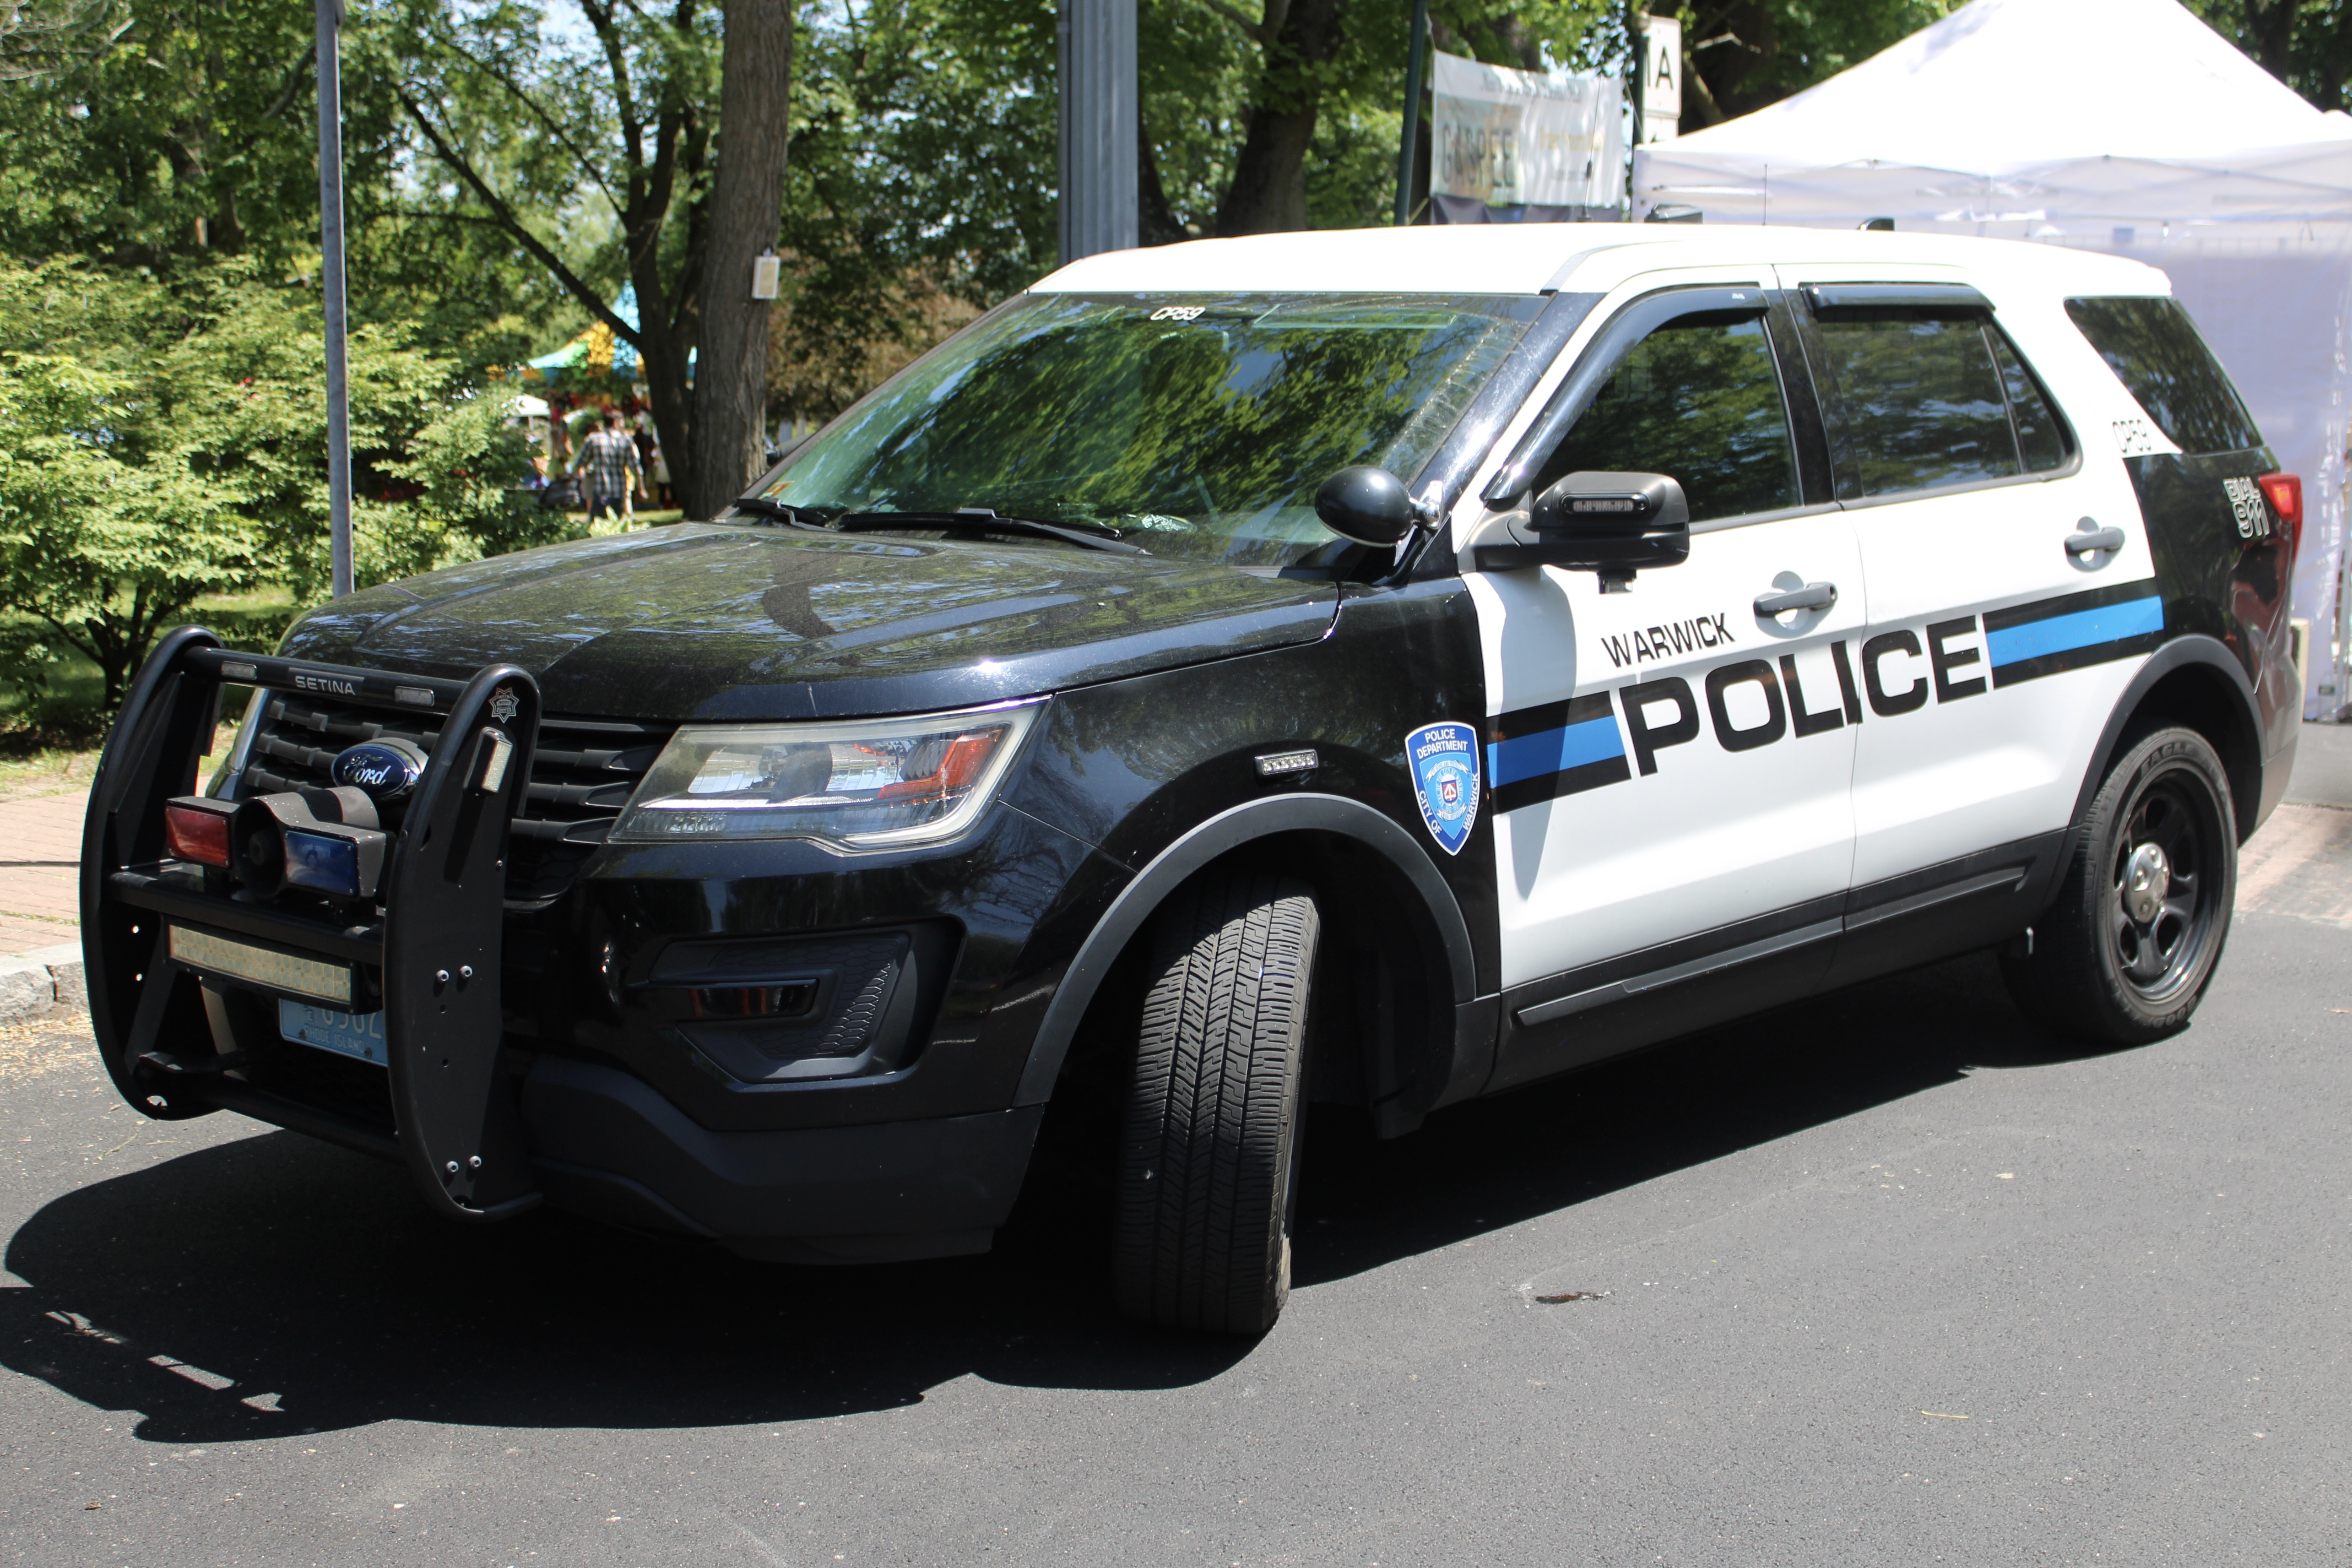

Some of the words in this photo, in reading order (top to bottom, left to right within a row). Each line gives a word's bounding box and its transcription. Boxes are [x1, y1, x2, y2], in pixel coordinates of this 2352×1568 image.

[1442, 123, 1515, 187] GASPEE
[1149, 306, 1206, 321] CP59
[2112, 418, 2151, 454] CP59
[2222, 476, 2261, 502] DIAL
[2232, 499, 2271, 538] 911
[1601, 612, 1735, 668] WARWICK
[294, 675, 356, 696] SETINA
[1619, 615, 1988, 777] POLICE
[1416, 740, 1468, 760] DEPARTMENT
[1424, 728, 1456, 743] POLICE
[342, 752, 391, 785] Ford
[2140, 741, 2196, 777] EAGLE
[1419, 790, 1433, 818] CITY
[1431, 819, 1442, 835] OF
[1462, 772, 1479, 831] WARWICK
[303, 1024, 331, 1044] RHODE
[335, 1032, 365, 1053] ISLAND
